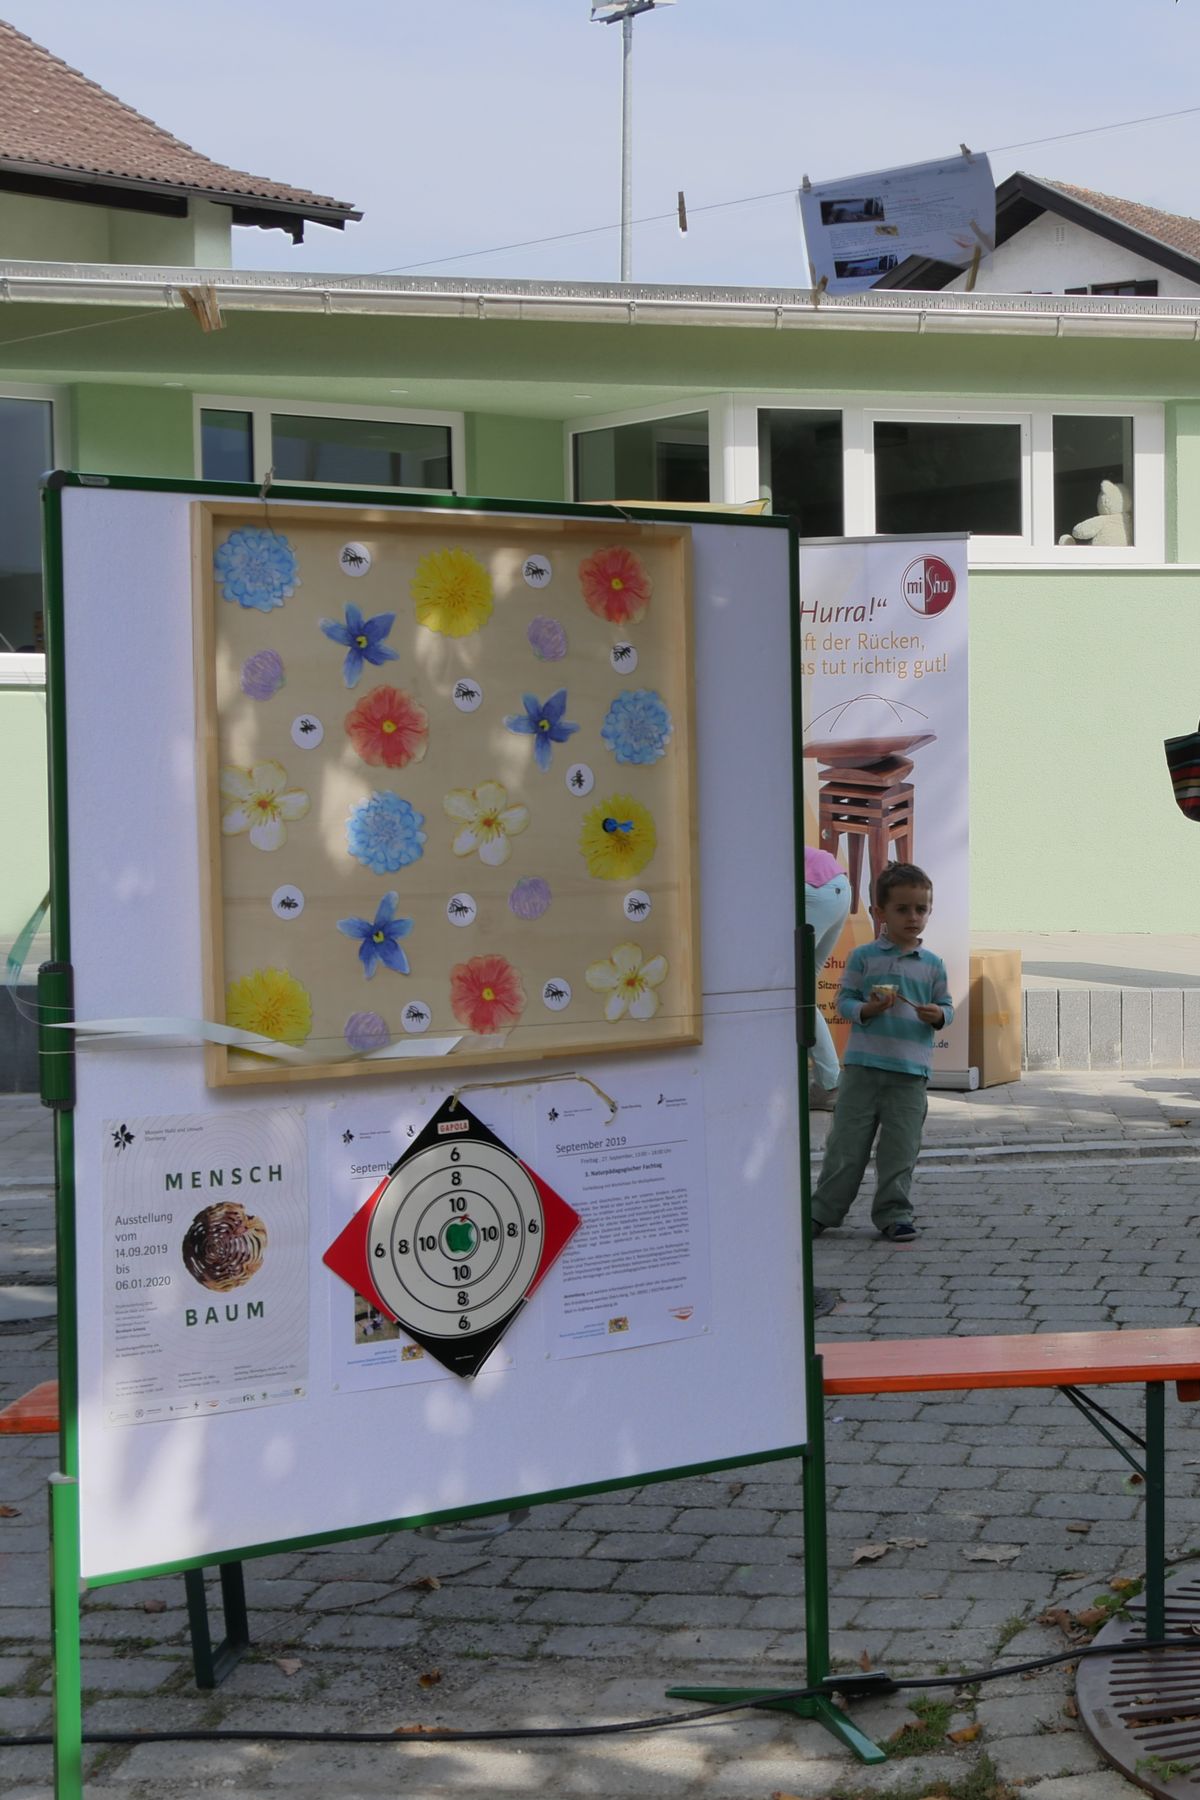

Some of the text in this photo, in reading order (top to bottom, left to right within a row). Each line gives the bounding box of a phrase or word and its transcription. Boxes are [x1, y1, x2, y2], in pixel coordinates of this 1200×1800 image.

[822, 632, 852, 651] der
[857, 630, 926, 652] Rücken,
[822, 659, 847, 676] tut
[852, 655, 908, 680] richtig
[913, 653, 948, 680] gut!
[555, 1136, 627, 1155] September 2019
[450, 1147, 462, 1162] 6
[165, 1164, 283, 1191] MENSCH
[451, 1171, 463, 1186] 8
[449, 1197, 468, 1213] 10
[115, 1212, 173, 1227] Ausstellung
[115, 1233, 137, 1242] vom
[374, 1219, 540, 1258] 6 8 10 10 8 6
[115, 1244, 168, 1259] 14.09.2019
[115, 1264, 130, 1275] bis
[453, 1264, 472, 1280] 10
[115, 1276, 171, 1291] 06.01.2020
[457, 1290, 470, 1306] 8
[185, 1301, 265, 1327] BAUM
[458, 1315, 471, 1331] 6
